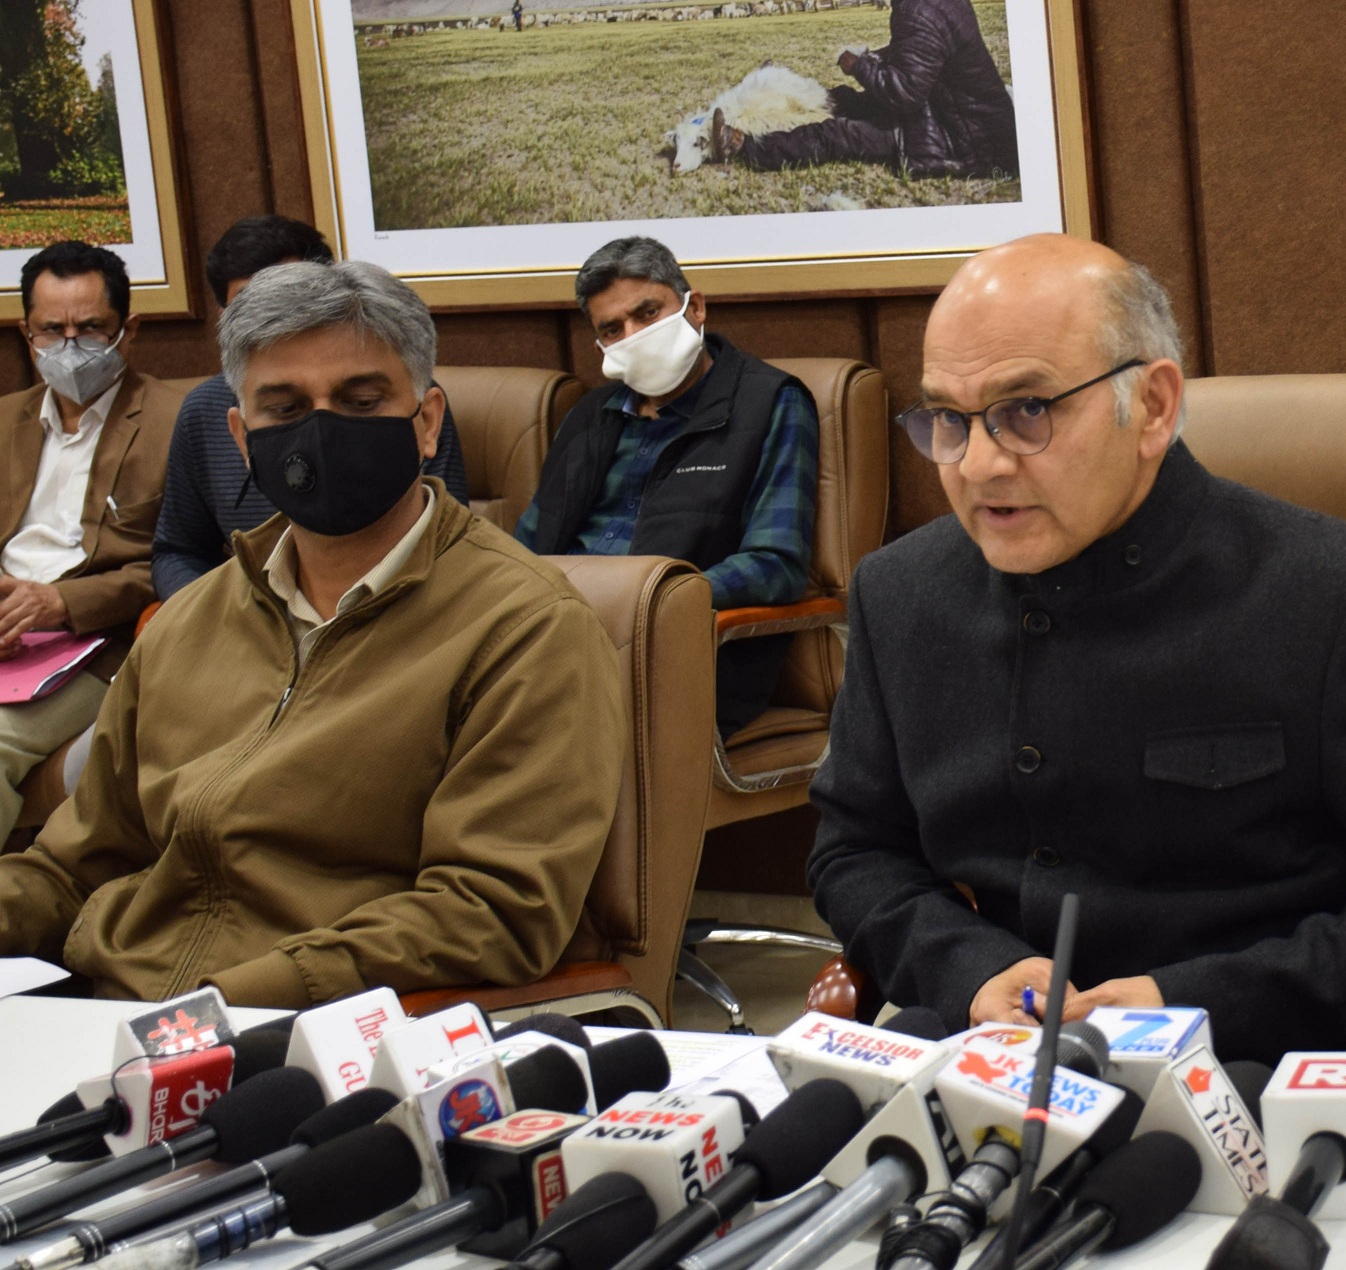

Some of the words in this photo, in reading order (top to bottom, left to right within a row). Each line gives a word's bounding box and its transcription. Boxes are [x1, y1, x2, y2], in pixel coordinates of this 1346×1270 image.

[354, 1006, 389, 1042] The
[818, 1039, 897, 1066] NEWS
[990, 1053, 1024, 1073] JK
[597, 1109, 706, 1128] NEWS
[585, 1126, 676, 1141] NOW
[1203, 1099, 1254, 1193] TIMES
